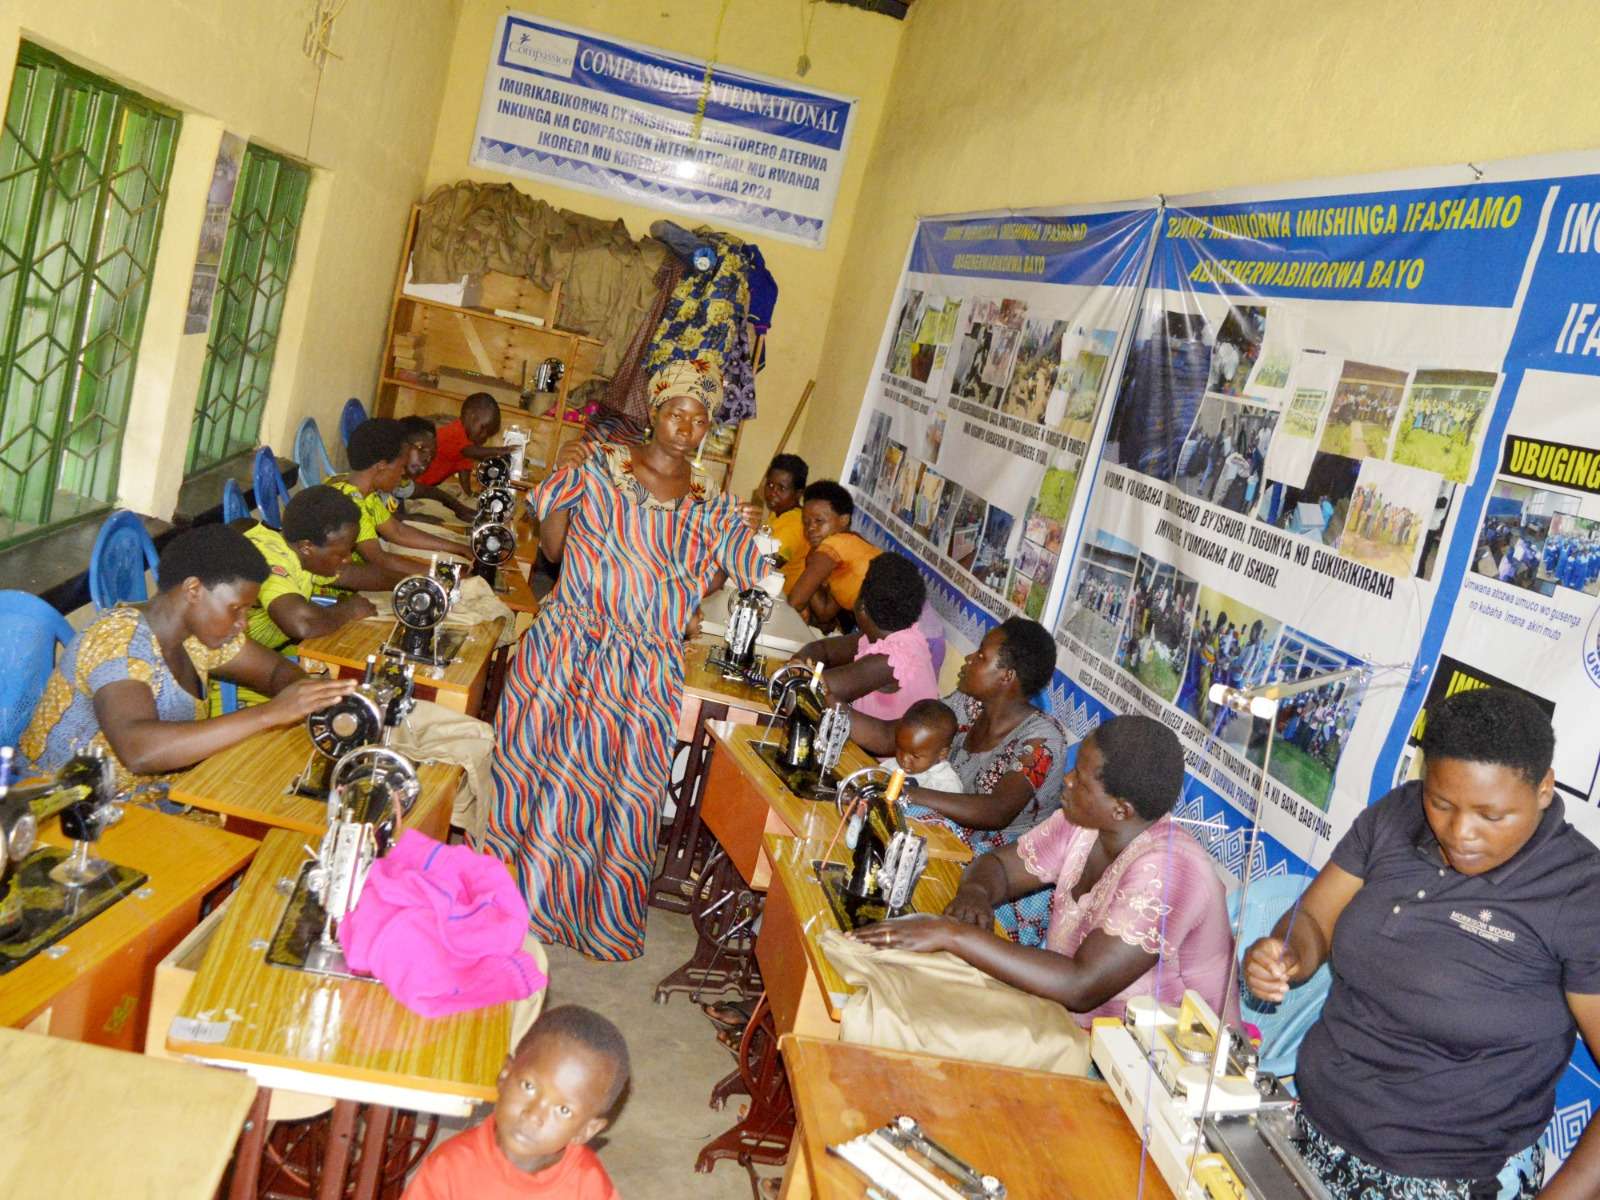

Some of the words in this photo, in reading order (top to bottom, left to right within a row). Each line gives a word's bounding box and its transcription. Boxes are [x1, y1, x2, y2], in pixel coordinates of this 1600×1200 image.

[508, 41, 572, 66] Compassion
[579, 48, 696, 94] COMPASSION
[704, 80, 840, 134] NTERNATIONAL
[497, 98, 551, 126] INKUNGA
[553, 112, 571, 129] NA
[571, 117, 652, 150] COMPASSION
[767, 161, 821, 192] RWANDA
[537, 130, 590, 157] IKORERA
[591, 145, 611, 162] MU
[741, 180, 773, 201] 2024
[778, 147, 829, 173] ATERWA
[1209, 211, 1291, 240] MUBIKORWA
[1296, 204, 1398, 237] IMISHINGA
[1402, 194, 1522, 232] IFASHAMO
[1366, 258, 1425, 289] BAYO
[1228, 550, 1245, 573] KU
[1247, 525, 1292, 560] TUGUMYA
[1293, 542, 1310, 567] NO
[1311, 549, 1395, 600] GUKURIKIRANA
[1281, 792, 1299, 818] BANA
[1298, 805, 1332, 841] BABYAWE
